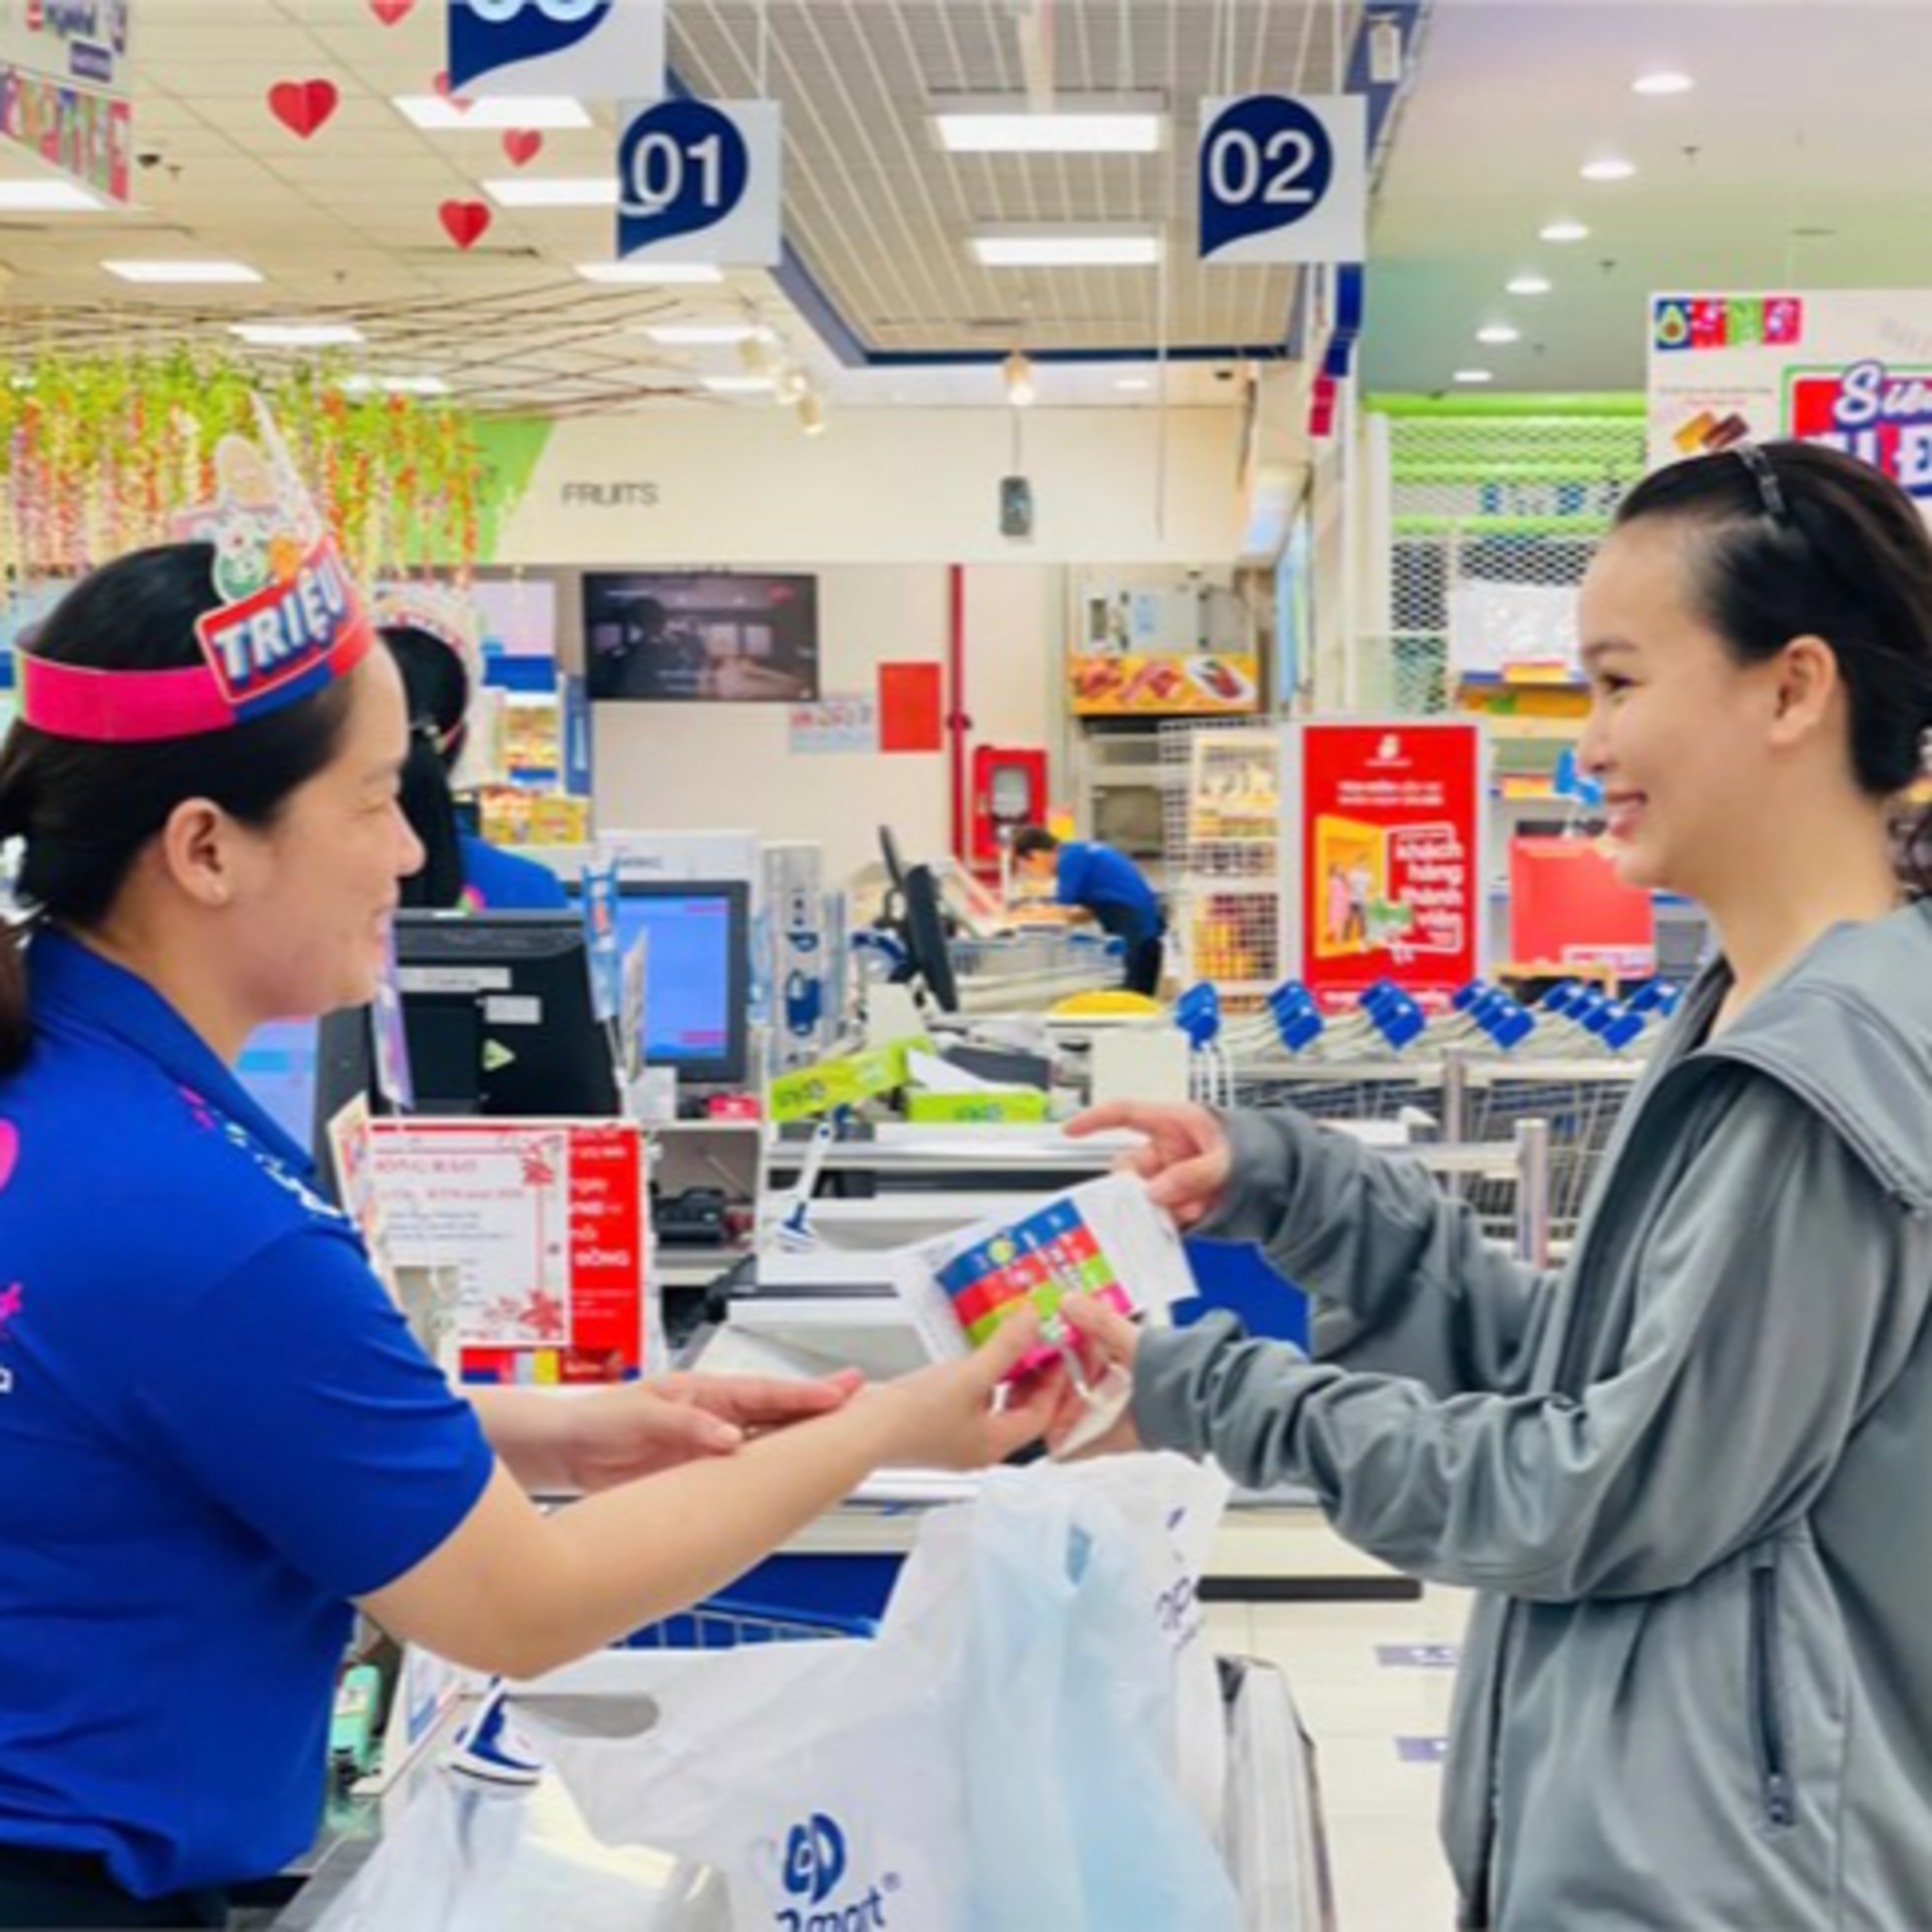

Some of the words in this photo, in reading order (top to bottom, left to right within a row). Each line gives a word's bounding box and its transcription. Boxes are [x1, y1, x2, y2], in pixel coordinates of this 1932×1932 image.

[633, 132, 721, 207] 01
[1208, 130, 1314, 204] 02
[562, 482, 659, 506] FRUITS
